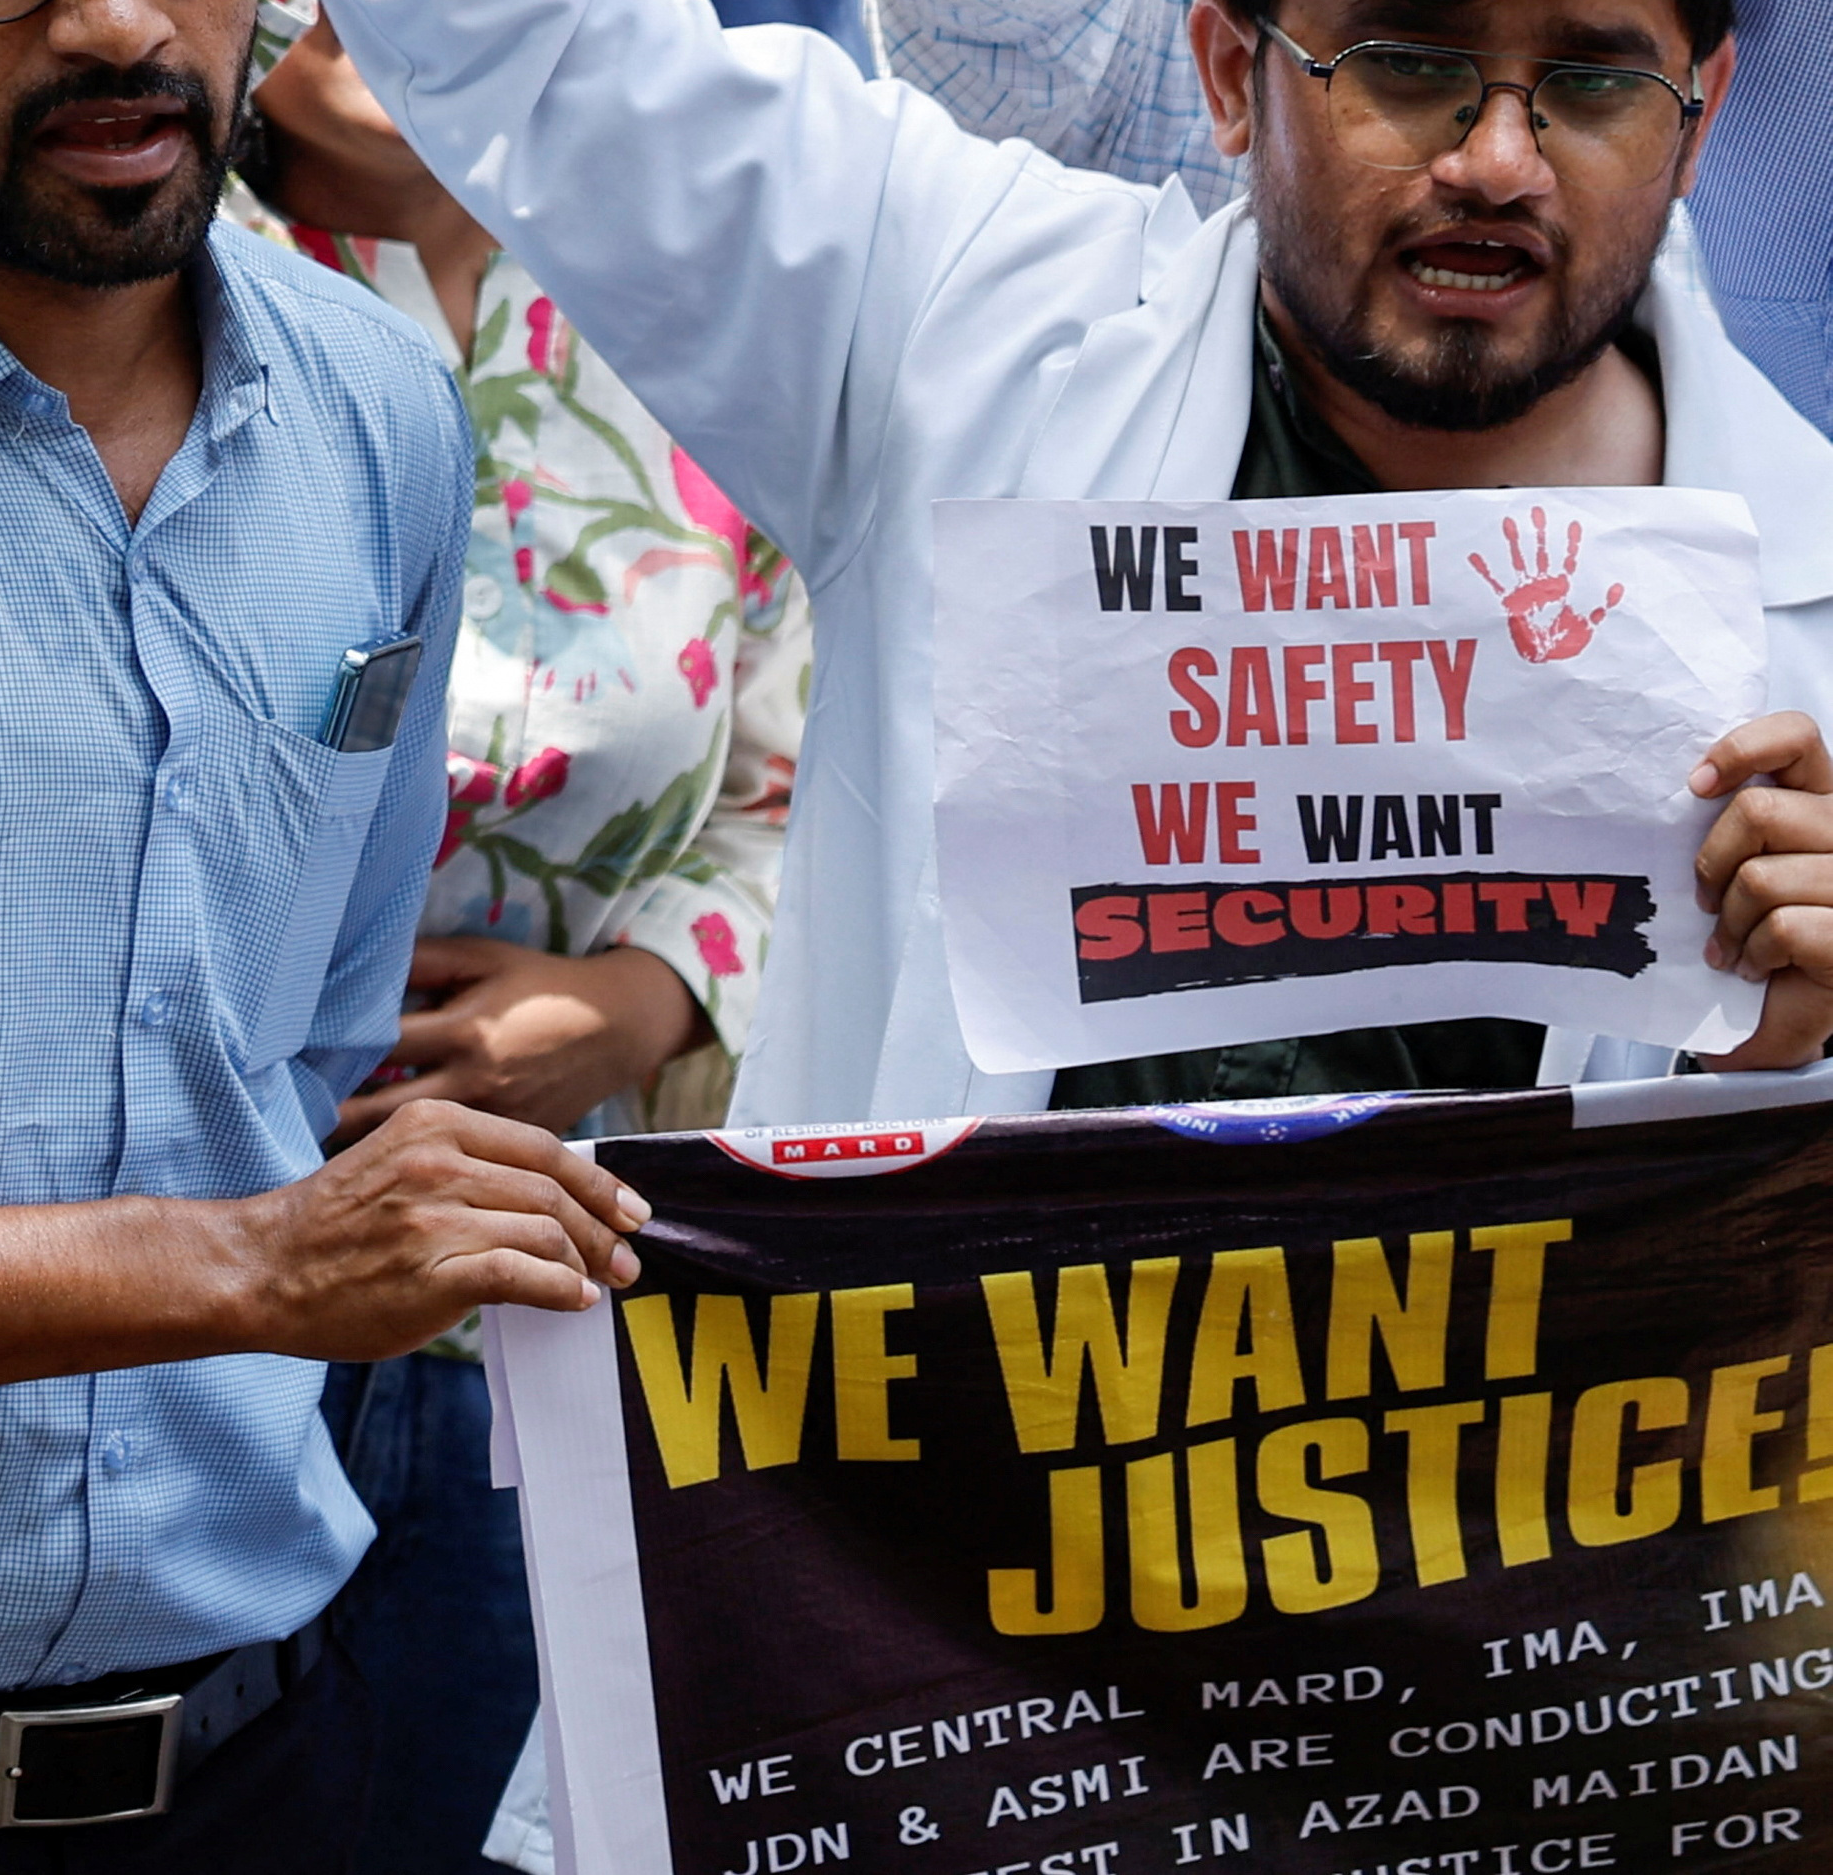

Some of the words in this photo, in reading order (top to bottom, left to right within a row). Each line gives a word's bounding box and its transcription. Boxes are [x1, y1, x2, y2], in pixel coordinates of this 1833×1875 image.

[1089, 525, 1202, 612] WE
[1233, 521, 1438, 612] WANT
[1167, 638, 1478, 750] SAFETY
[1132, 781, 1261, 866] WE
[1296, 793, 1502, 864] WANT
[1075, 881, 1616, 962] SECURITY
[622, 1282, 922, 1491] WE
[980, 1218, 1574, 1455] WANT
[986, 1343, 1833, 1638] JUSTICE!
[709, 1755, 796, 1805] WE
[845, 1685, 1145, 1778] CENTRAL
[1202, 1665, 1416, 1710] MARD,
[1483, 1620, 1637, 1679] IMA,
[1701, 1572, 1824, 1633] IMA
[723, 1823, 850, 1875] JDN
[899, 1806, 940, 1846] &
[987, 1756, 1150, 1828] ASMI
[1203, 1734, 1334, 1780] ARE
[1389, 1648, 1833, 1757] CONDUCTING
[1172, 1814, 1250, 1864] IN
[1299, 1785, 1480, 1838] AZAD
[1533, 1734, 1798, 1809] MAIDAN
[1671, 1807, 1802, 1856] FOR
